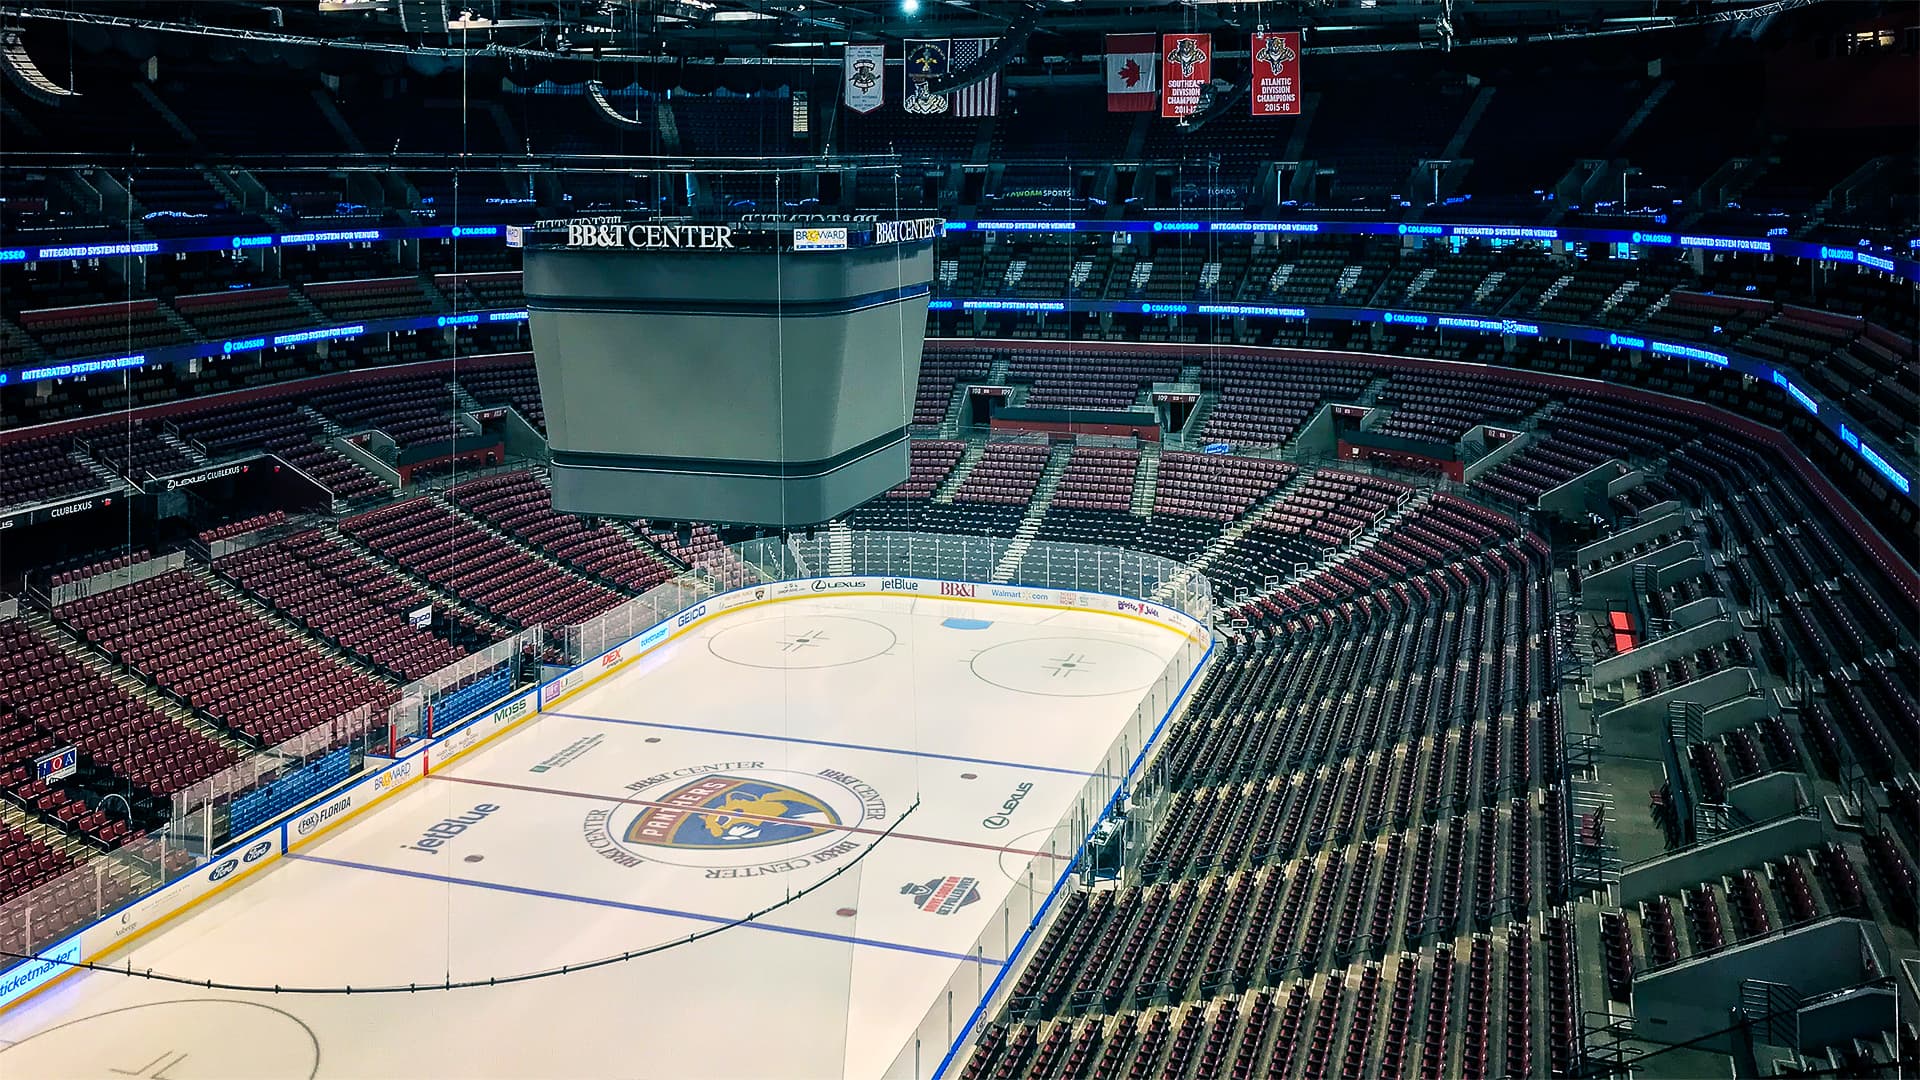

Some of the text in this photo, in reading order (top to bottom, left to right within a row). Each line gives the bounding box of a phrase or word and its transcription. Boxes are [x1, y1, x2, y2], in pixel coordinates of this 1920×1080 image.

[1261, 78, 1292, 86] ATLANTIC
[1172, 88, 1200, 96] DIVISION
[1262, 86, 1290, 94] DIVISION
[1257, 94, 1295, 102] CHAMPIONS
[1265, 103, 1290, 112] 2015-16
[341, 232, 353, 240] FOR
[462, 227, 497, 235] COLOSSEO
[567, 224, 735, 248] BB&T CENTER
[796, 229, 845, 241] BROWARD
[876, 218, 936, 244] BB&T CENTER
[1453, 227, 1494, 235] INTEGRATED
[1495, 228, 1520, 236] SYSTEM
[1642, 233, 1671, 243] COLOSSEO
[241, 236, 272, 245] COLOSSEO
[1681, 237, 1714, 246] INTEGRATED
[1715, 238, 1736, 247] SYSTEM
[1737, 240, 1749, 249] FOR
[40, 243, 158, 259] INTEGRATED SYSTEM FOR VENUES
[1828, 249, 1853, 260] COLOSSEO
[1393, 314, 1427, 323] COLOSSEO
[1439, 318, 1479, 327] INTEGRATED
[233, 339, 264, 350] COLOSSEO
[22, 365, 71, 380] INTEGRATED
[72, 362, 100, 374] SYSTEM
[101, 359, 116, 370] FOR
[176, 474, 206, 487] LEXUS
[51, 500, 92, 518] CLUBLEXUS
[881, 577, 918, 591] jetBlue
[991, 589, 1021, 598] Walmart
[677, 604, 706, 628] GEICO
[602, 648, 622, 667] DEX
[494, 699, 527, 724] MOSS
[624, 761, 764, 791] BB&T CENTER
[818, 769, 886, 820] BB&T CENTER
[997, 782, 1034, 815] LEXUS
[302, 796, 351, 828] FOX FLORIDA
[642, 782, 727, 836] PANTHERS
[400, 804, 500, 854] jetBlue
[584, 810, 645, 868] BB&T CENTER
[248, 842, 267, 860] Ford
[705, 841, 860, 879] BB&T CENTER
[213, 860, 236, 880] Ford
[0, 948, 74, 997] ticketmaster
